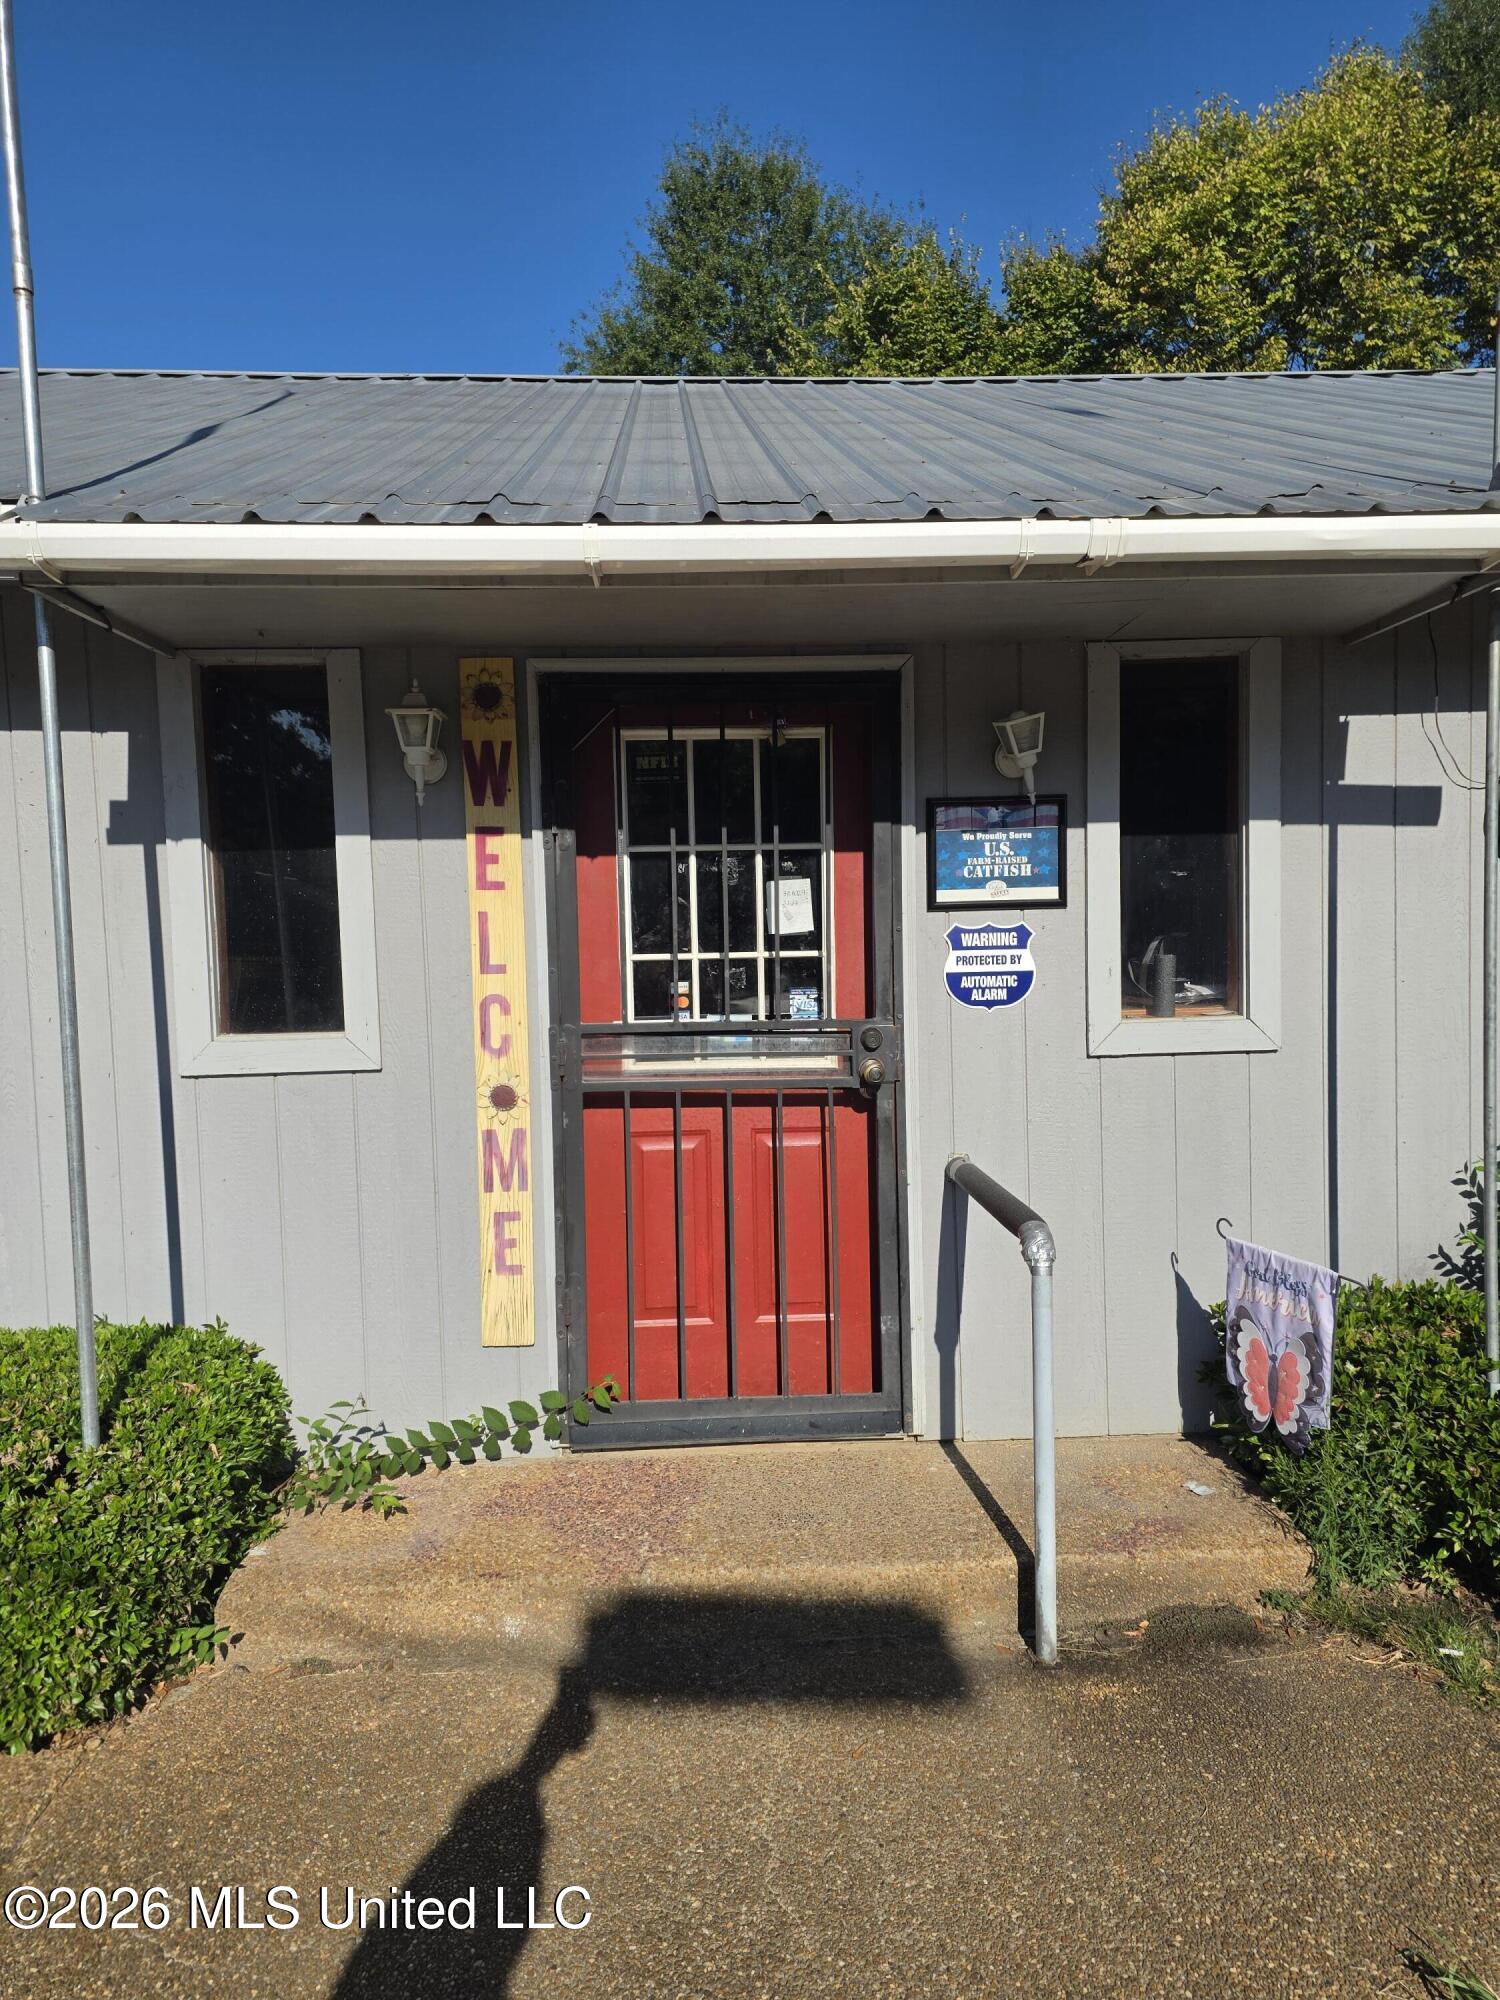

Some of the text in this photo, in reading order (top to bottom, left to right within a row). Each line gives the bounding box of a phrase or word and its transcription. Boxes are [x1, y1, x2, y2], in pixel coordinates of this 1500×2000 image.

[962, 833, 975, 841] We
[977, 832, 1007, 841] Proudly
[984, 842, 1014, 856] U.S.
[967, 857, 1028, 865] FARM-RAISED
[963, 864, 1032, 878] CATFISH
[961, 932, 1018, 947] WARNING
[955, 954, 1022, 966] PROTECTED BY
[960, 975, 1018, 988] AUTOMATIC
[971, 988, 1008, 1001] ALARM
